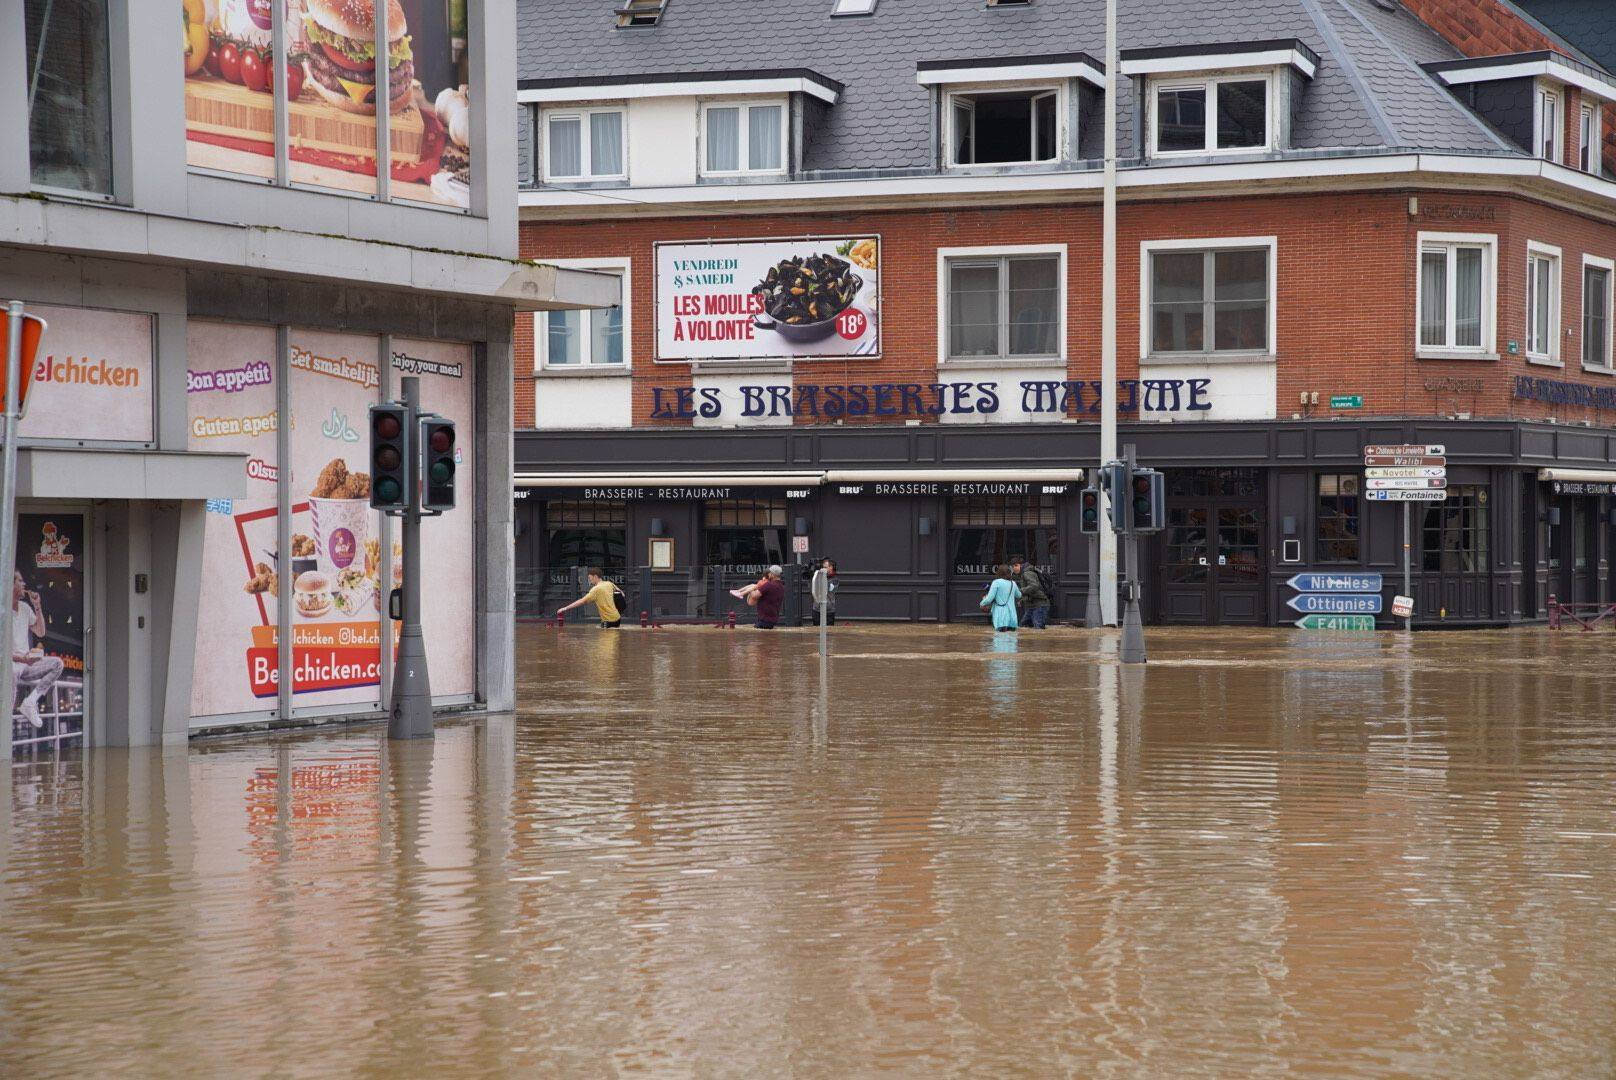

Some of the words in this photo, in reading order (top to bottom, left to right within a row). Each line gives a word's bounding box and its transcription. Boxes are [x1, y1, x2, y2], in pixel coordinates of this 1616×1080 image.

[673, 259, 738, 271] VENDREDI
[674, 275, 684, 288] &
[686, 274, 734, 285] SAMEDI
[673, 295, 701, 315] LES
[704, 293, 765, 315] MOULES
[673, 317, 685, 341] À
[687, 314, 755, 341] VOLONTÉ
[35, 355, 139, 387] elchicken
[312, 357, 380, 387] smakelijk
[416, 360, 439, 374] your
[440, 363, 462, 377] meal
[215, 362, 271, 391] appétit
[650, 387, 722, 418] LES
[740, 382, 999, 416] BRASSERIES
[193, 417, 241, 437] Guten
[1394, 457, 1423, 465] Walibi
[246, 459, 279, 481] Olsu
[1383, 469, 1416, 477] Novotel
[584, 488, 644, 498] BRASSERIE
[659, 488, 731, 498] RESTAURANT
[786, 490, 807, 498] BRU
[839, 486, 860, 494] BRU
[875, 484, 938, 494] BRASSERIE
[953, 484, 1030, 494] RESTAURANT
[1042, 486, 1063, 494] BRU
[1400, 490, 1444, 500] Fontaines
[957, 564, 989, 574] SALLE
[1311, 576, 1370, 589] Nivelles
[1307, 597, 1375, 612] Ottignies
[1318, 618, 1348, 630] E411
[272, 627, 334, 645] blchicken
[409, 670, 415, 678] 2
